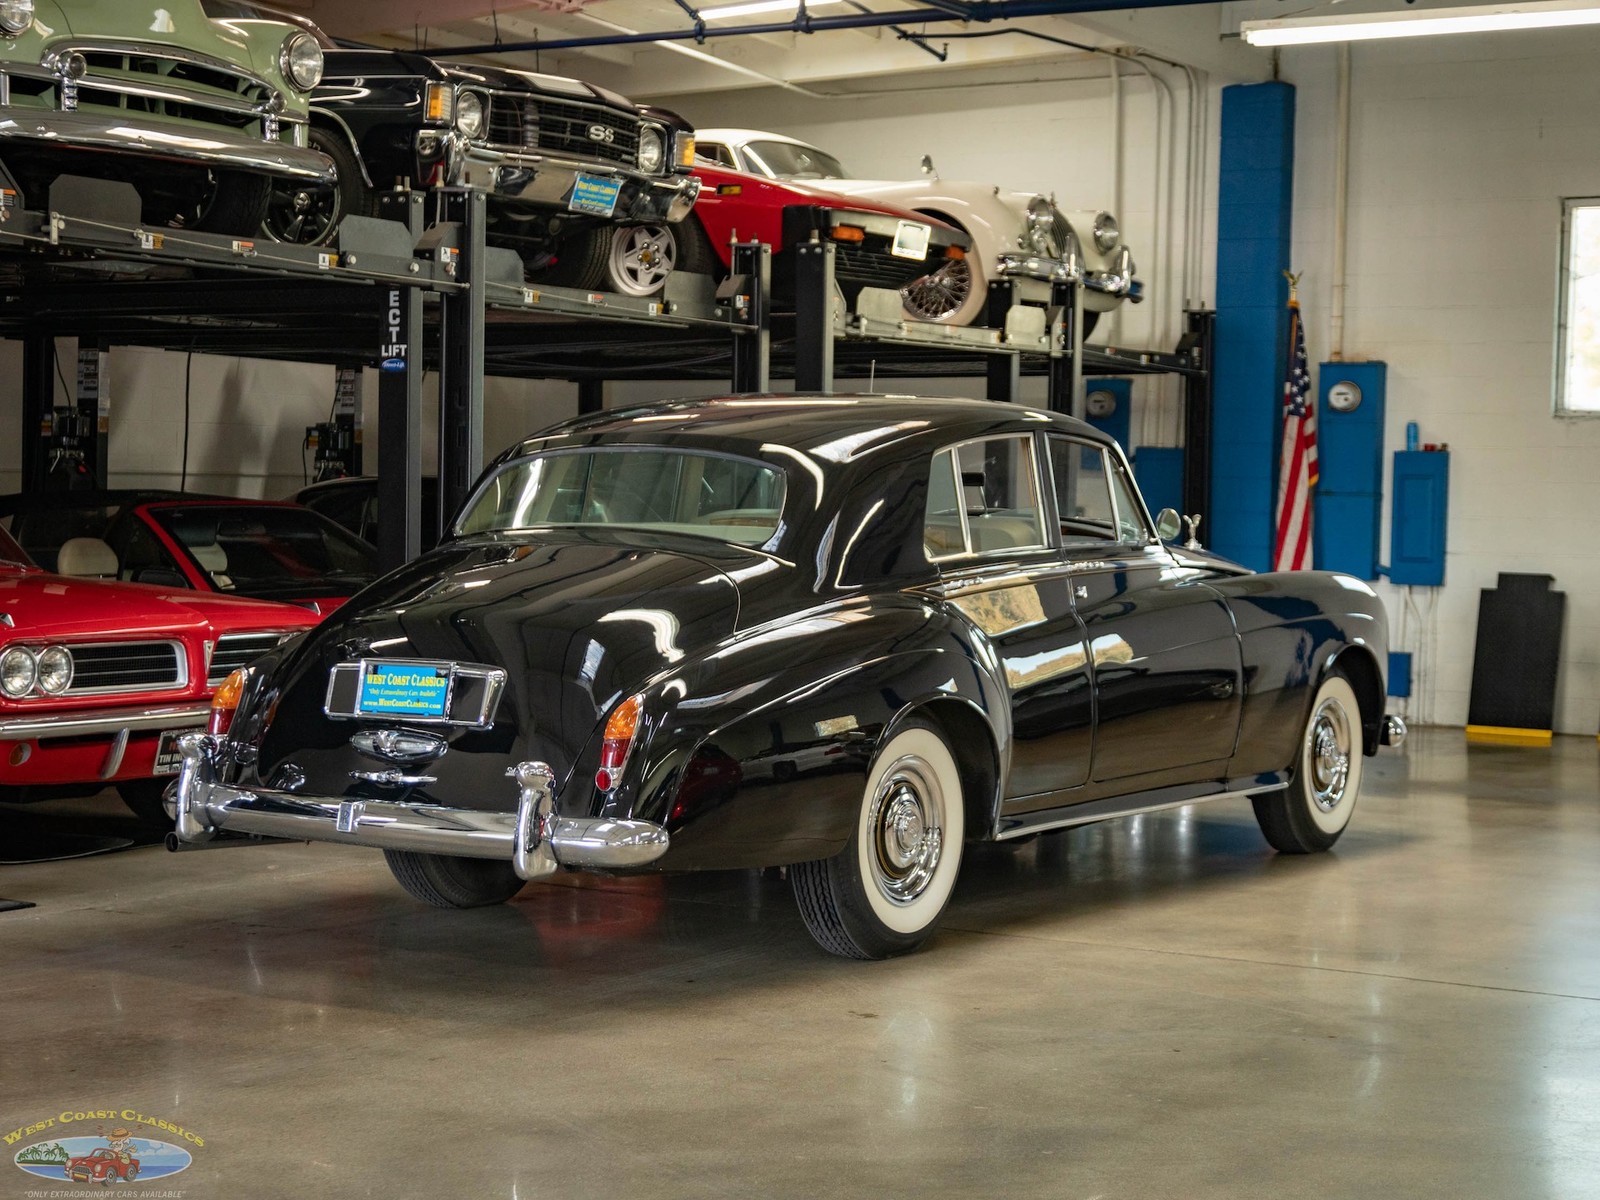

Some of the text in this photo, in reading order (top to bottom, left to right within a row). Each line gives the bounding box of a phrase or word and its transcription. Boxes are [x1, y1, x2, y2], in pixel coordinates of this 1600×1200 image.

[590, 125, 614, 143] SS
[381, 344, 407, 357] LIFT
[366, 673, 446, 688] WEST COAST CLASSICS
[159, 754, 172, 764] TIN
